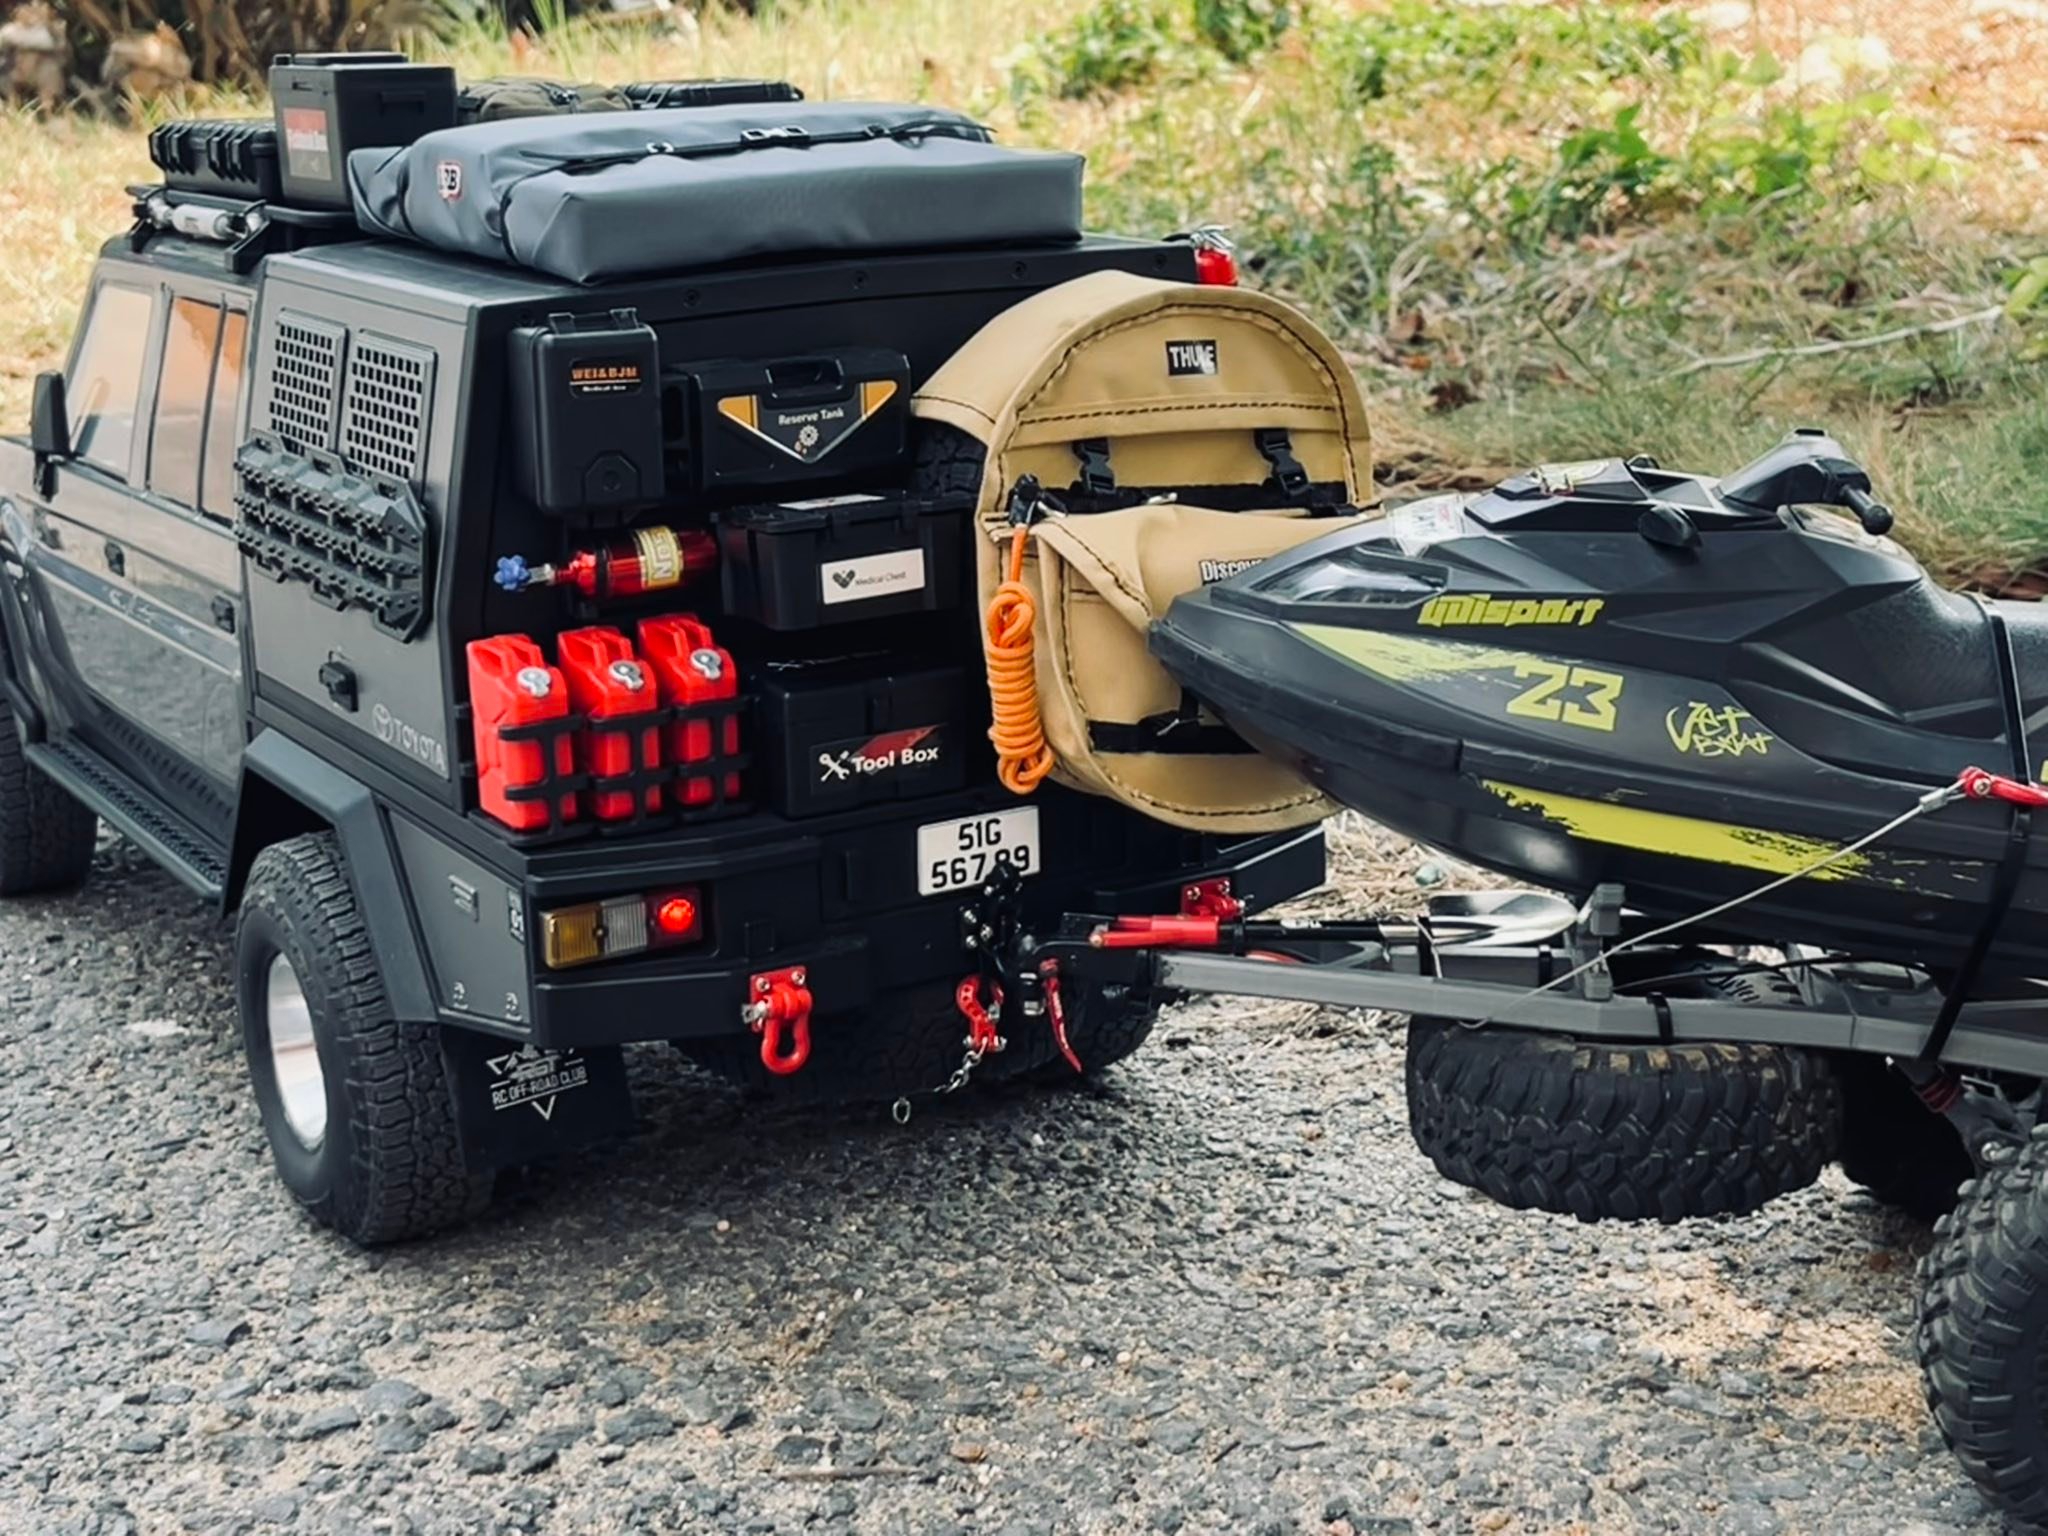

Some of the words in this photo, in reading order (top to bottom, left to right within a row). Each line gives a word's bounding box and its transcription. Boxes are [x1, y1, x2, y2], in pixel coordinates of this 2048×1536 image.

[778, 412, 819, 426] Reserve
[820, 407, 844, 420] Tank
[1506, 658, 1624, 732] 23
[394, 717, 447, 773] TOYOTA
[851, 750, 895, 773] Tool
[901, 747, 939, 765] Box
[958, 818, 1001, 851] 51G
[492, 1088, 508, 1105] RC
[559, 1065, 587, 1085] CLUB
